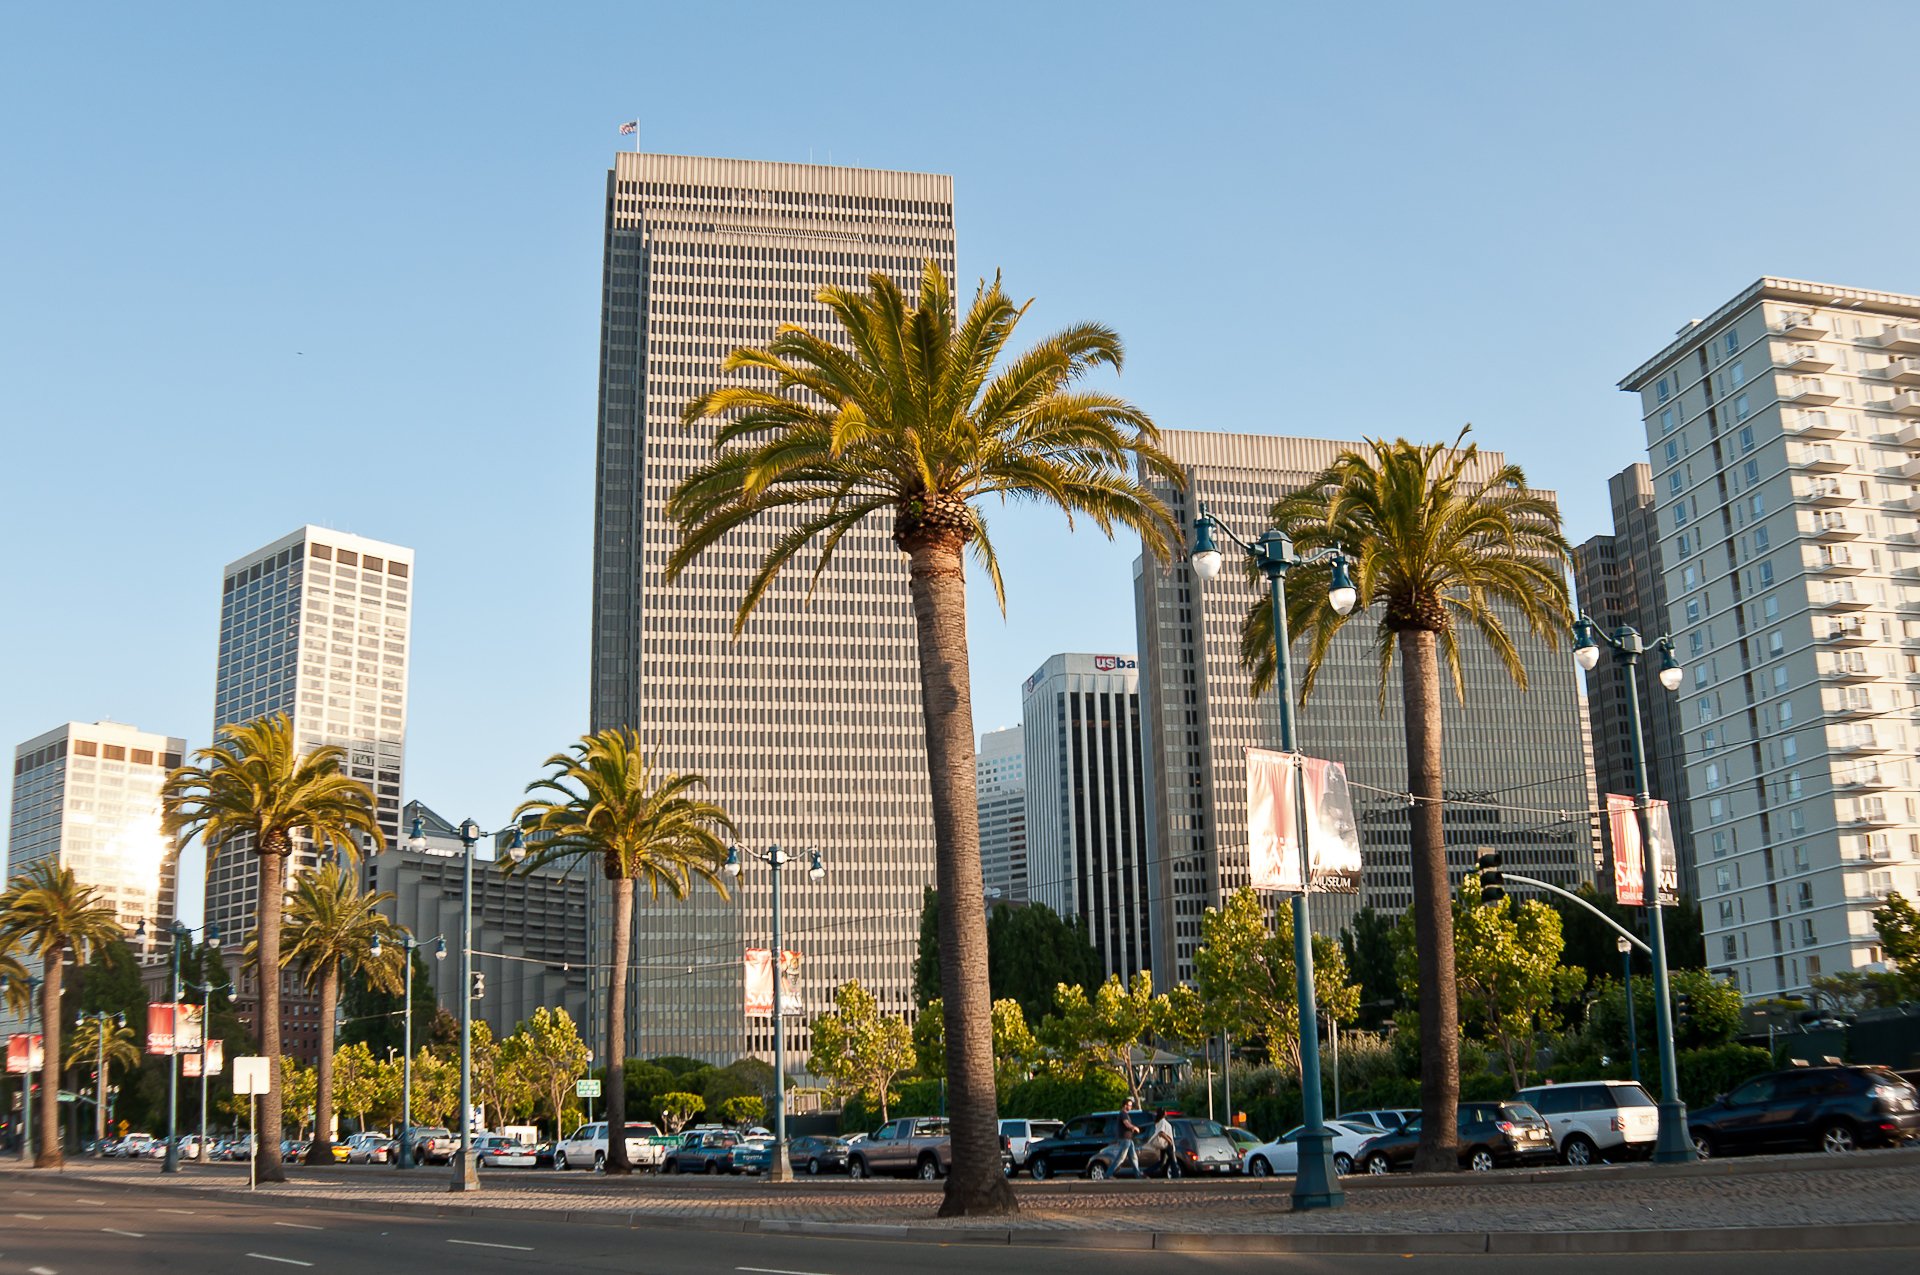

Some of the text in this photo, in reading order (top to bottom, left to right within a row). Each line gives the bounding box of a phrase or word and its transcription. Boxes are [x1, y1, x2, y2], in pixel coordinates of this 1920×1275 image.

[1096, 656, 1139, 669] usba
[1312, 876, 1351, 888] MUSEUM
[1657, 870, 1678, 892] RAI
